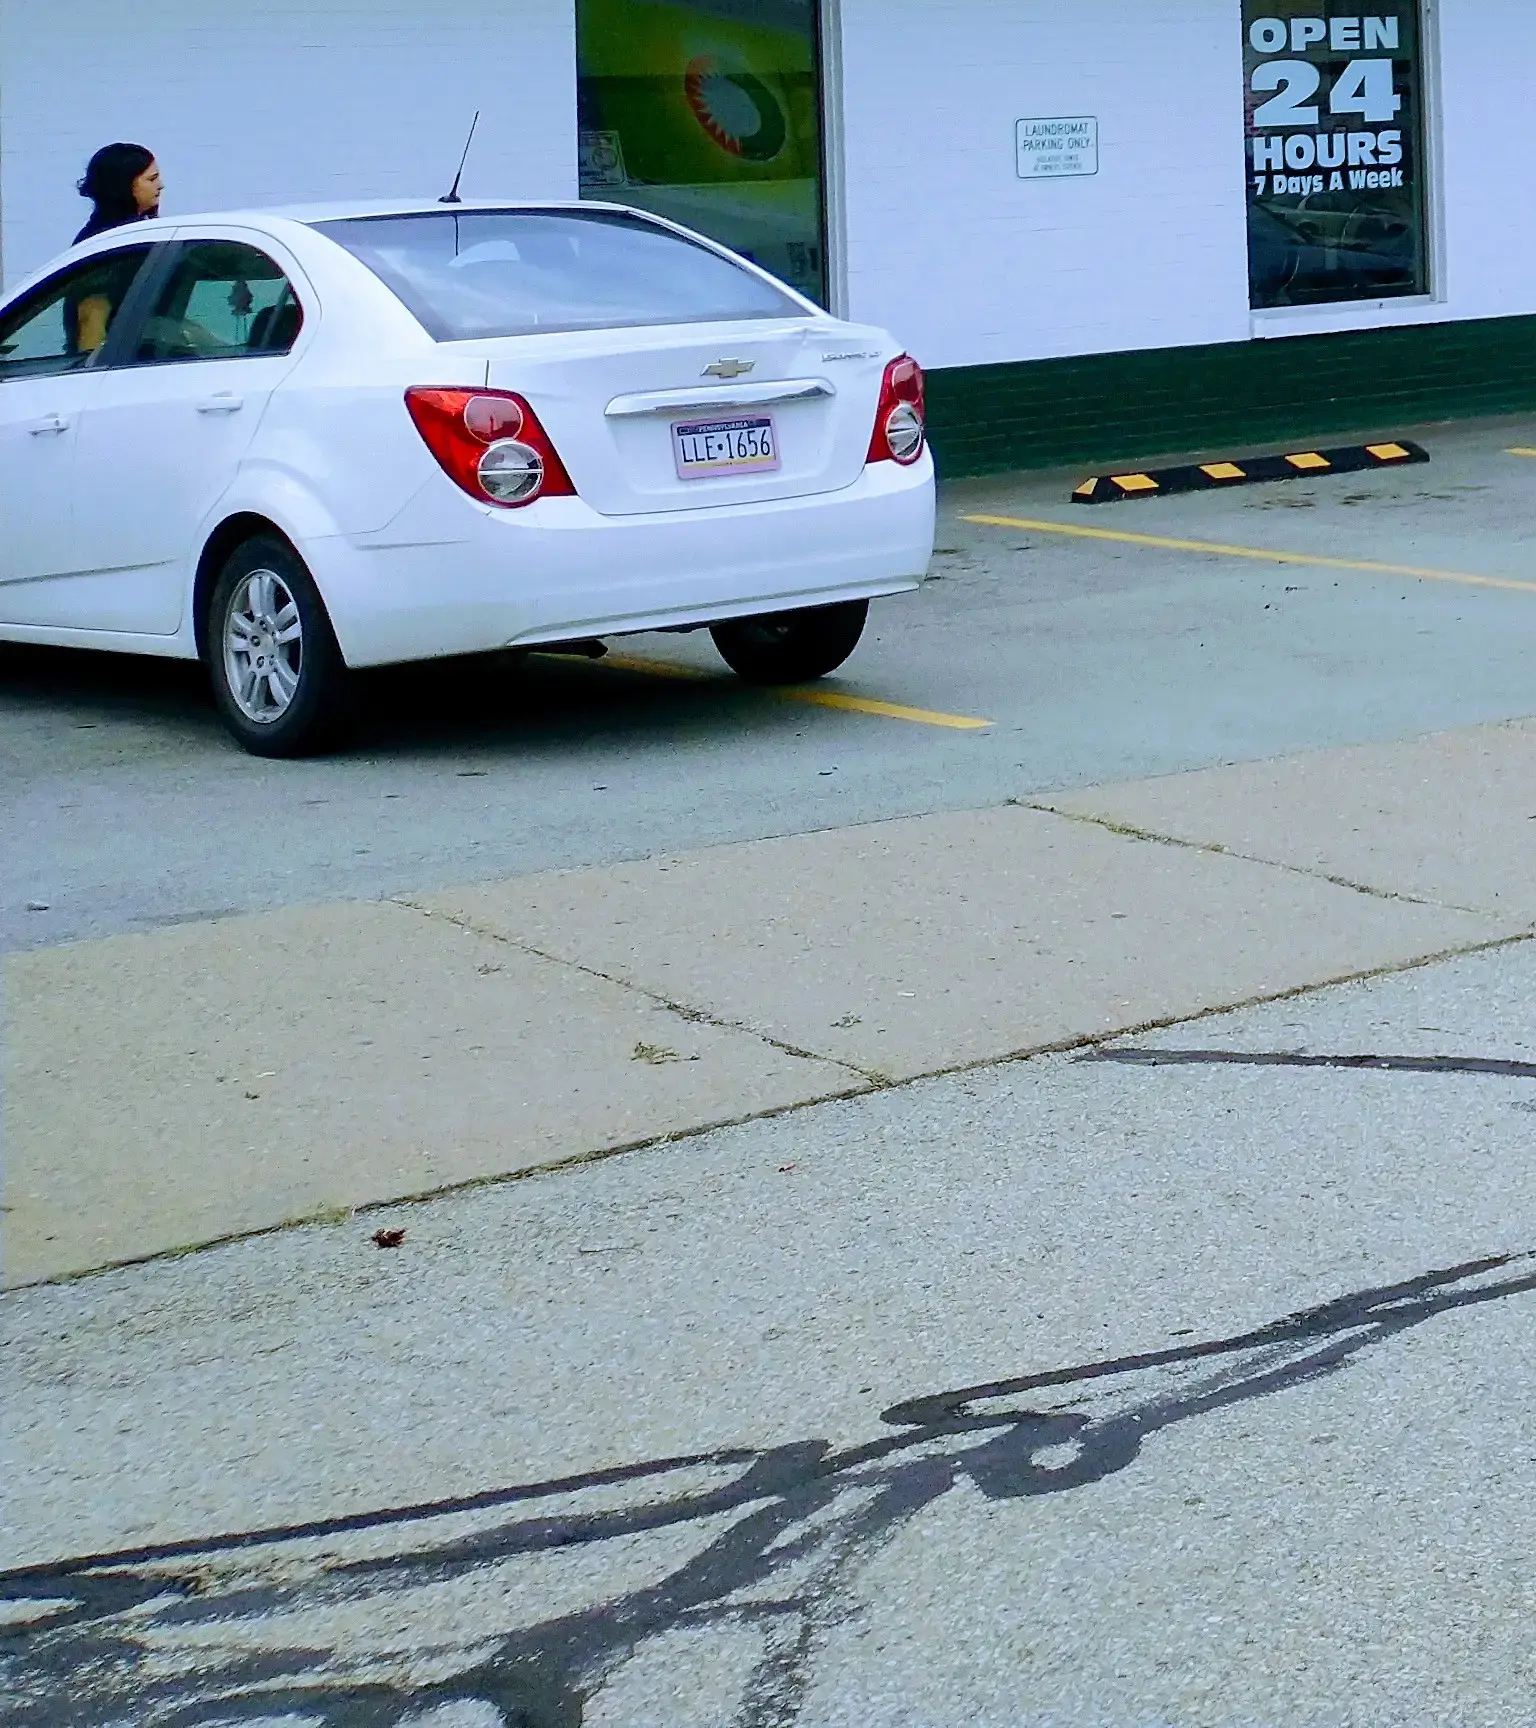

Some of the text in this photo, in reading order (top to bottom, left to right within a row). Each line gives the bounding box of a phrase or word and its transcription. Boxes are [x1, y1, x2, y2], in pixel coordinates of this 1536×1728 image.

[1249, 16, 1399, 53] OPEN
[1251, 58, 1401, 127] 24
[1023, 137, 1091, 152] PARKING ONLY
[1025, 123, 1088, 137] LAUNDROMAT
[1253, 129, 1403, 171] HOURS
[1254, 166, 1403, 197] 7 Days A Week
